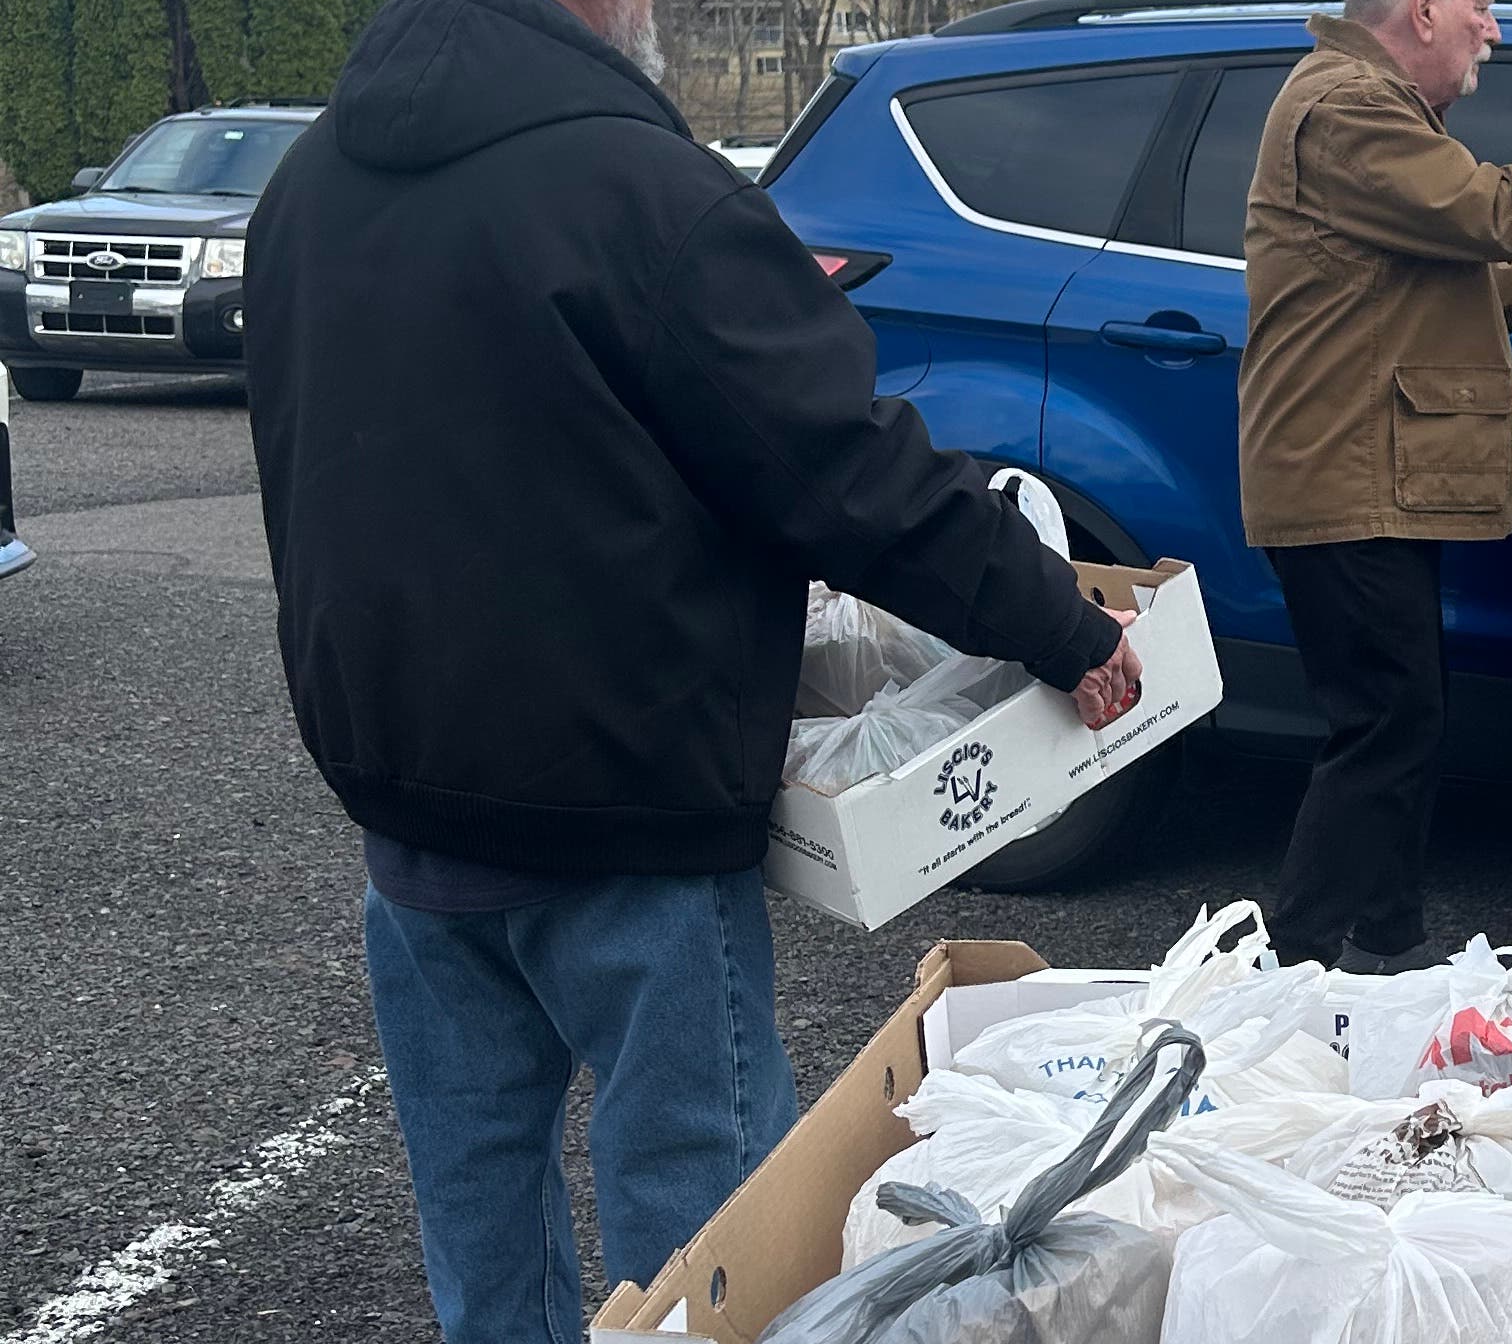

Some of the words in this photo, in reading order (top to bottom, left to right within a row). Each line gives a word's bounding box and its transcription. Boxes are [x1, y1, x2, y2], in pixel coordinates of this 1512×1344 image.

[933, 741, 994, 795] LISCIO'S
[939, 780, 998, 831] BAKERY
[966, 831, 985, 846] with
[985, 822, 1000, 834] the
